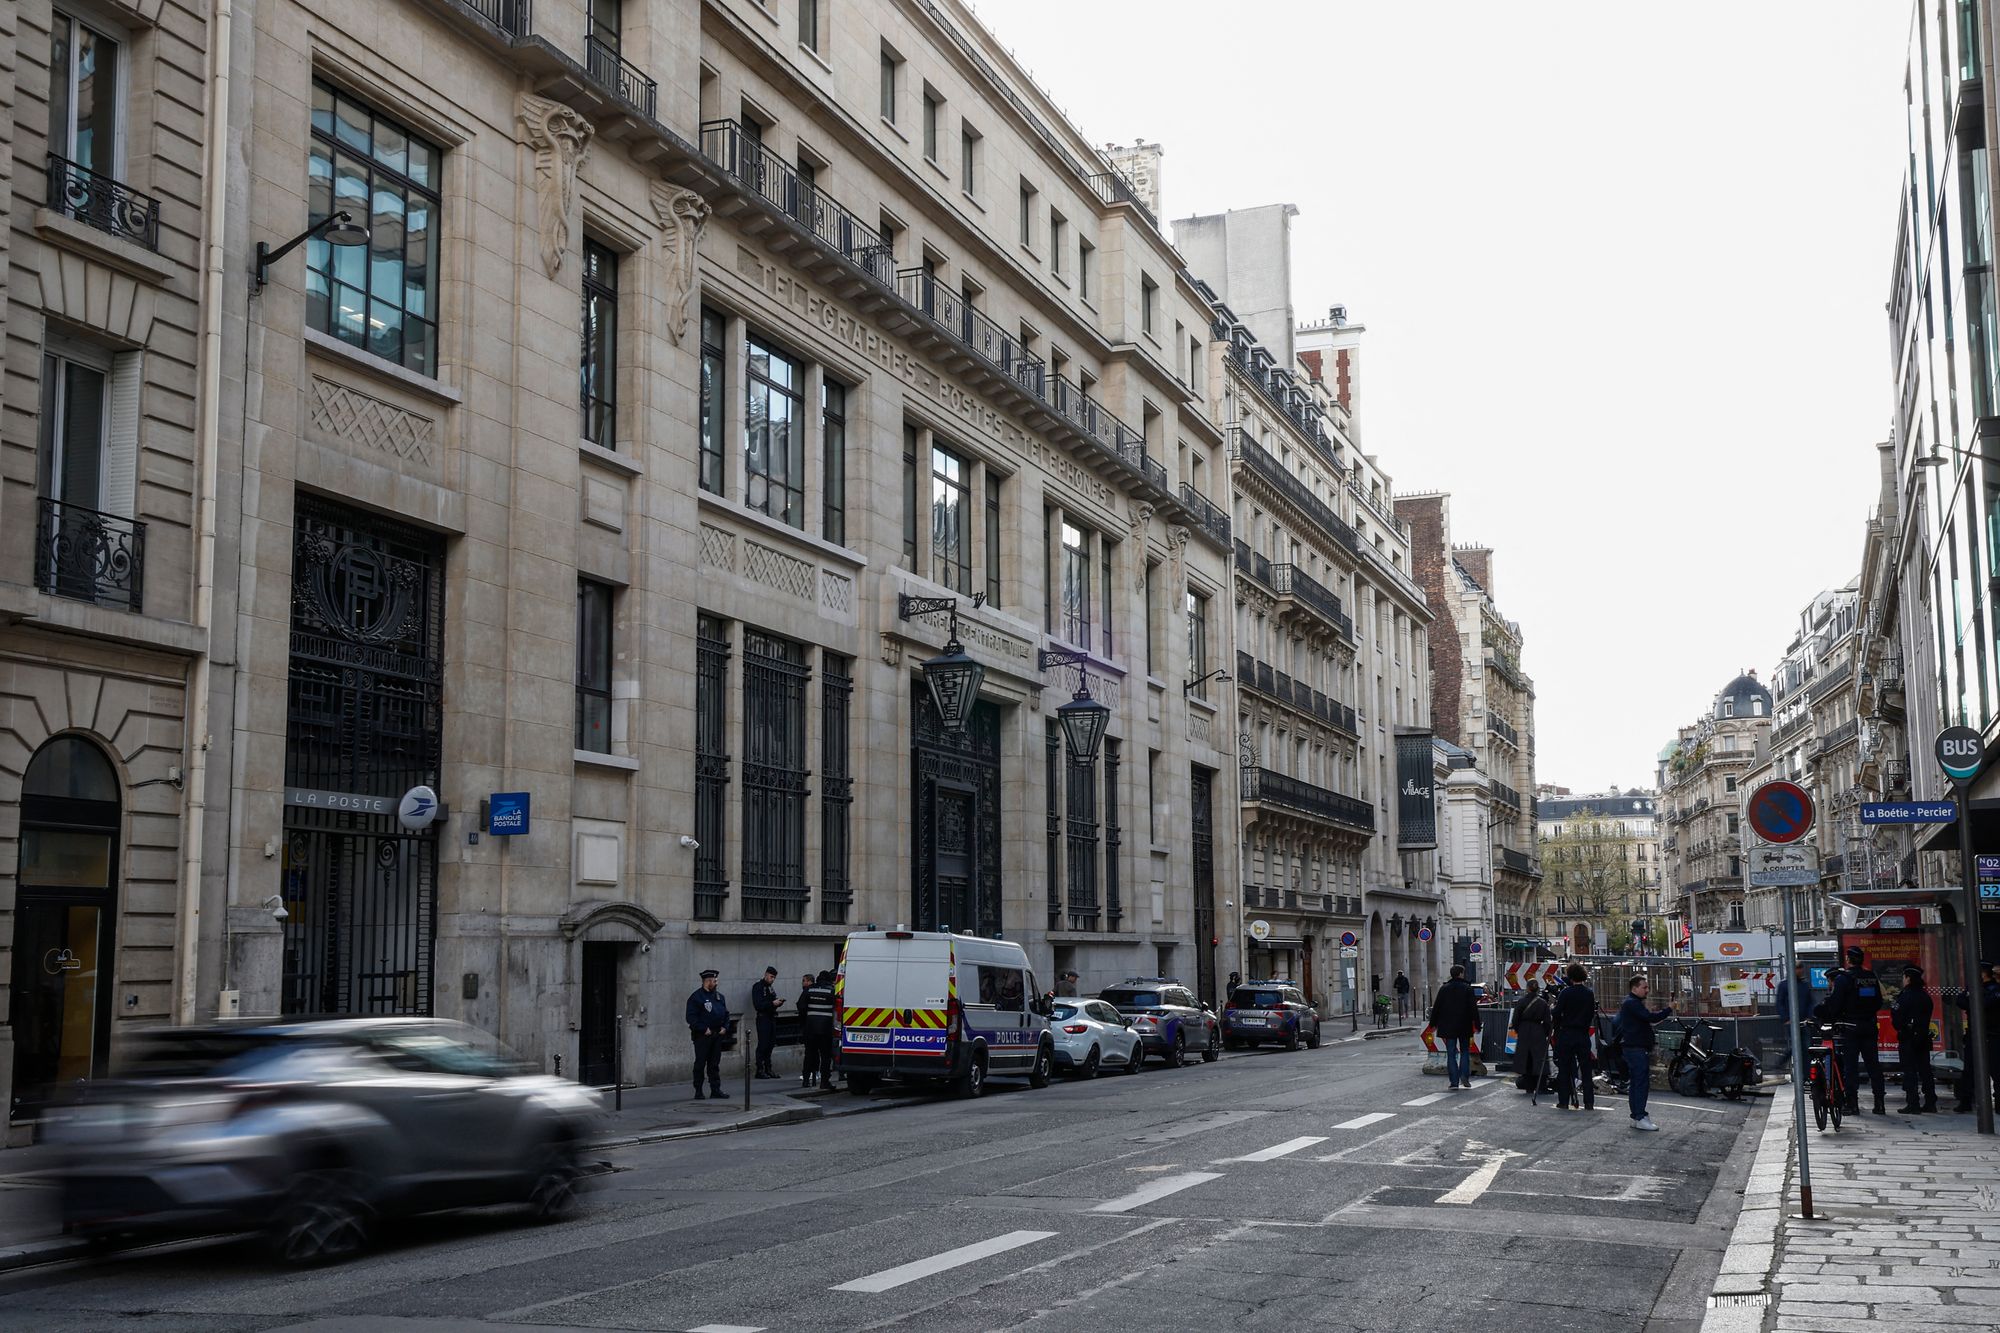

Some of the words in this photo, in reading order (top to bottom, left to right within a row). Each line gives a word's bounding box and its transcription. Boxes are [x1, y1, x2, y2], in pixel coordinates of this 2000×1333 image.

[940, 382, 1003, 437] POSTES
[1020, 433, 1107, 504] TELEPHONES
[1943, 739, 1978, 756] BUS
[1402, 787, 1430, 796] VILLAGE
[295, 792, 316, 804] LA
[328, 795, 382, 811] POSTE
[1863, 809, 1875, 818] La
[1877, 808, 1909, 818] Boétie
[1917, 807, 1952, 817] Percier
[1983, 885, 2000, 897] 52
[894, 1035, 926, 1043] POLICE
[996, 1031, 1020, 1044] POLICE
